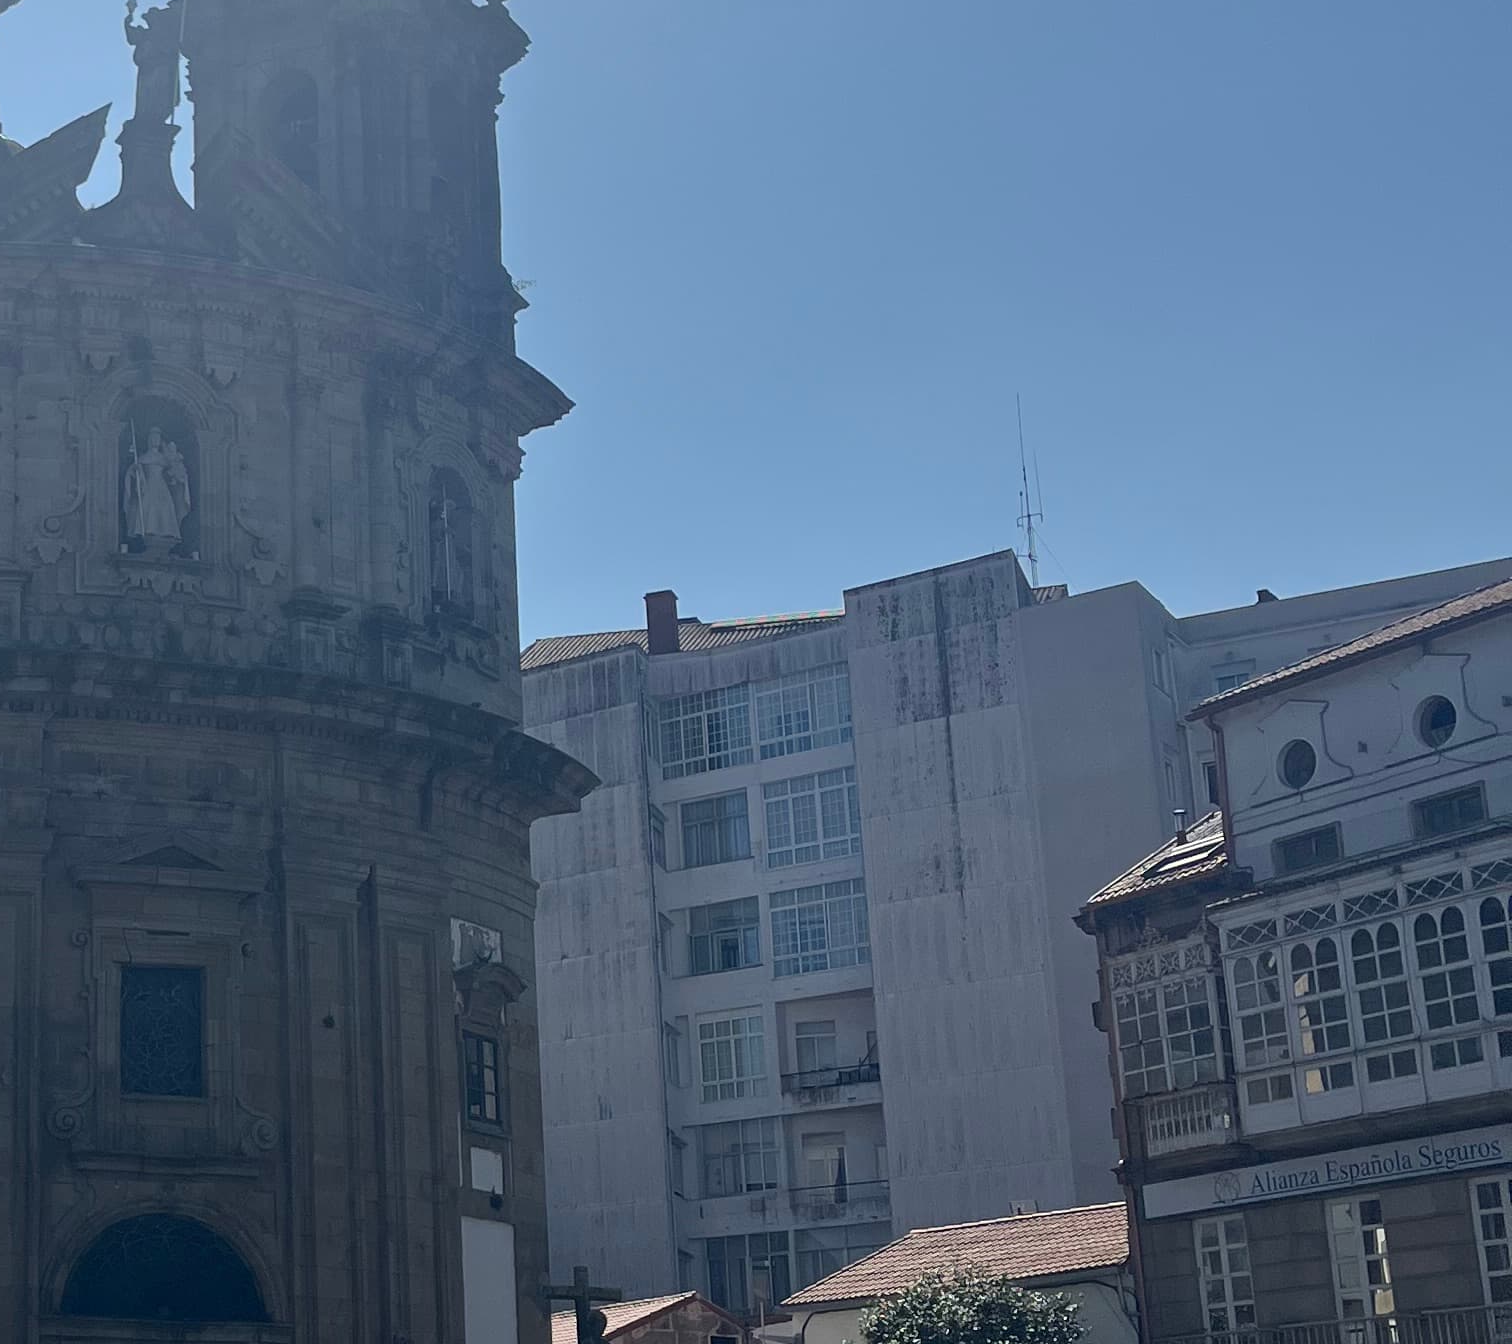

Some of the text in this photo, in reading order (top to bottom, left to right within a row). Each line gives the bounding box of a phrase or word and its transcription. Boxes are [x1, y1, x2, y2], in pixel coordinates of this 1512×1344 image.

[1251, 1138, 1502, 1195] Alianza Española Seguros
